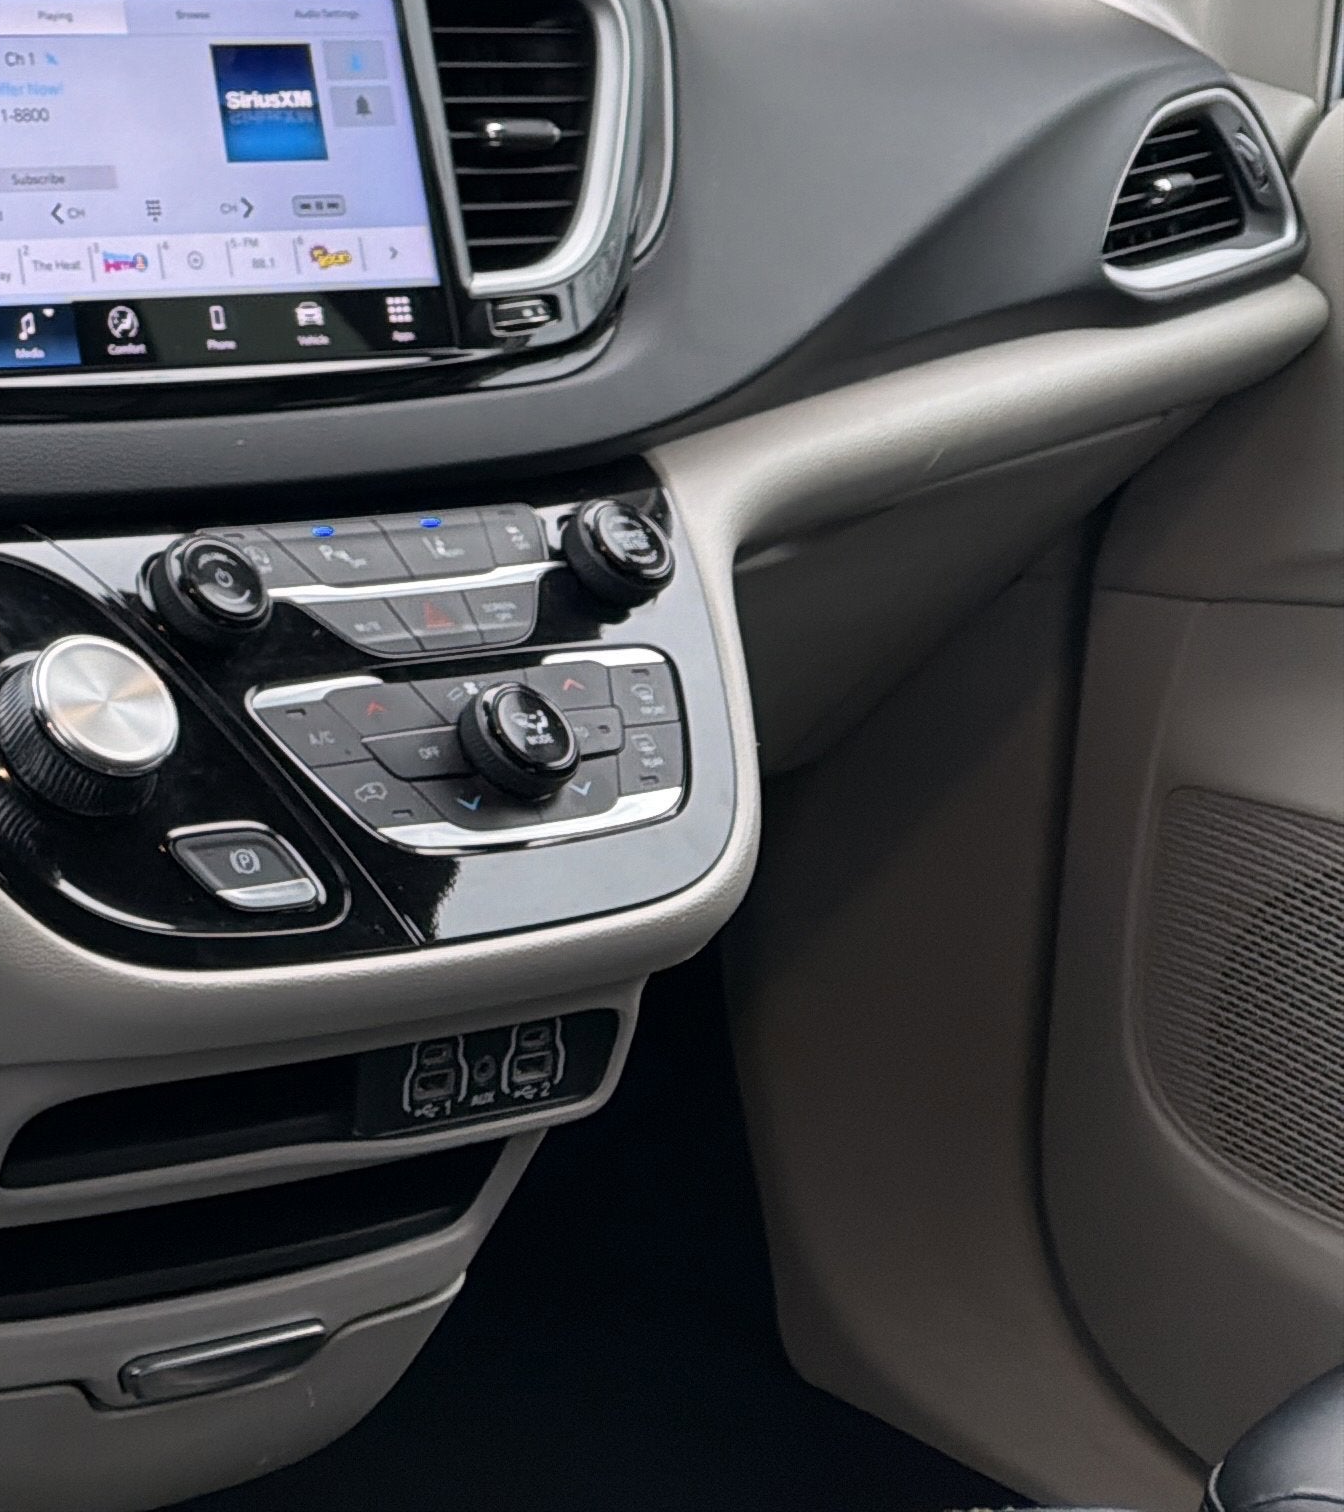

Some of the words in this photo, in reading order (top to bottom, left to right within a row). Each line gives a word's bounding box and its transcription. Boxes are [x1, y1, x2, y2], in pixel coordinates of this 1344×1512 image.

[37, 8, 73, 24] Playing
[4, 51, 26, 67] Ch
[225, 89, 313, 110] SiriusXM
[11, 172, 66, 188] Subscribe
[33, 258, 54, 271] The
[55, 257, 81, 270] Heat
[14, 347, 46, 360] Media
[107, 343, 147, 356] Comfort
[417, 745, 442, 760] OFF
[539, 1081, 552, 1098] 2
[470, 1092, 495, 1107] AUX
